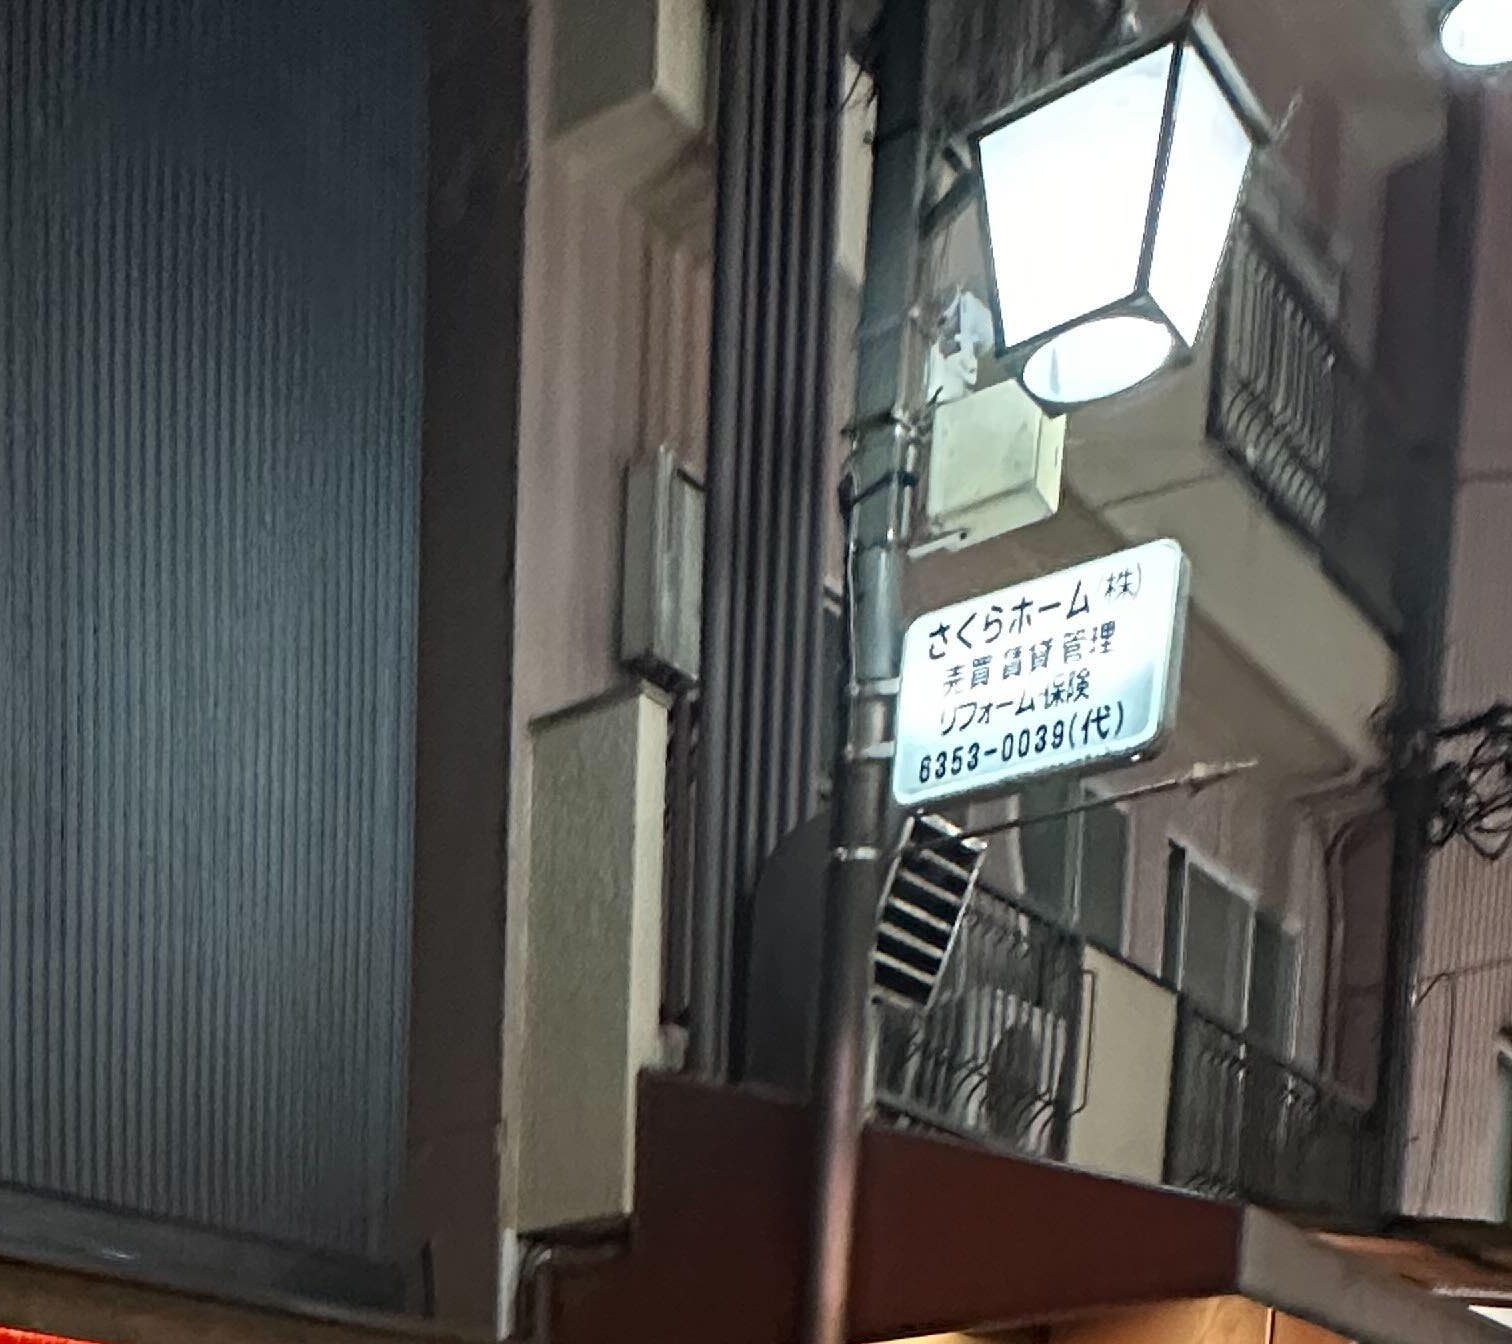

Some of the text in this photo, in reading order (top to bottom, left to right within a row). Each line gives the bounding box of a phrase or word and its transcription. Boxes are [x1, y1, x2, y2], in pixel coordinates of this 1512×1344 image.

[929, 580, 1090, 660] さくらホーム
[919, 700, 1124, 783] 6353-0039(代)
